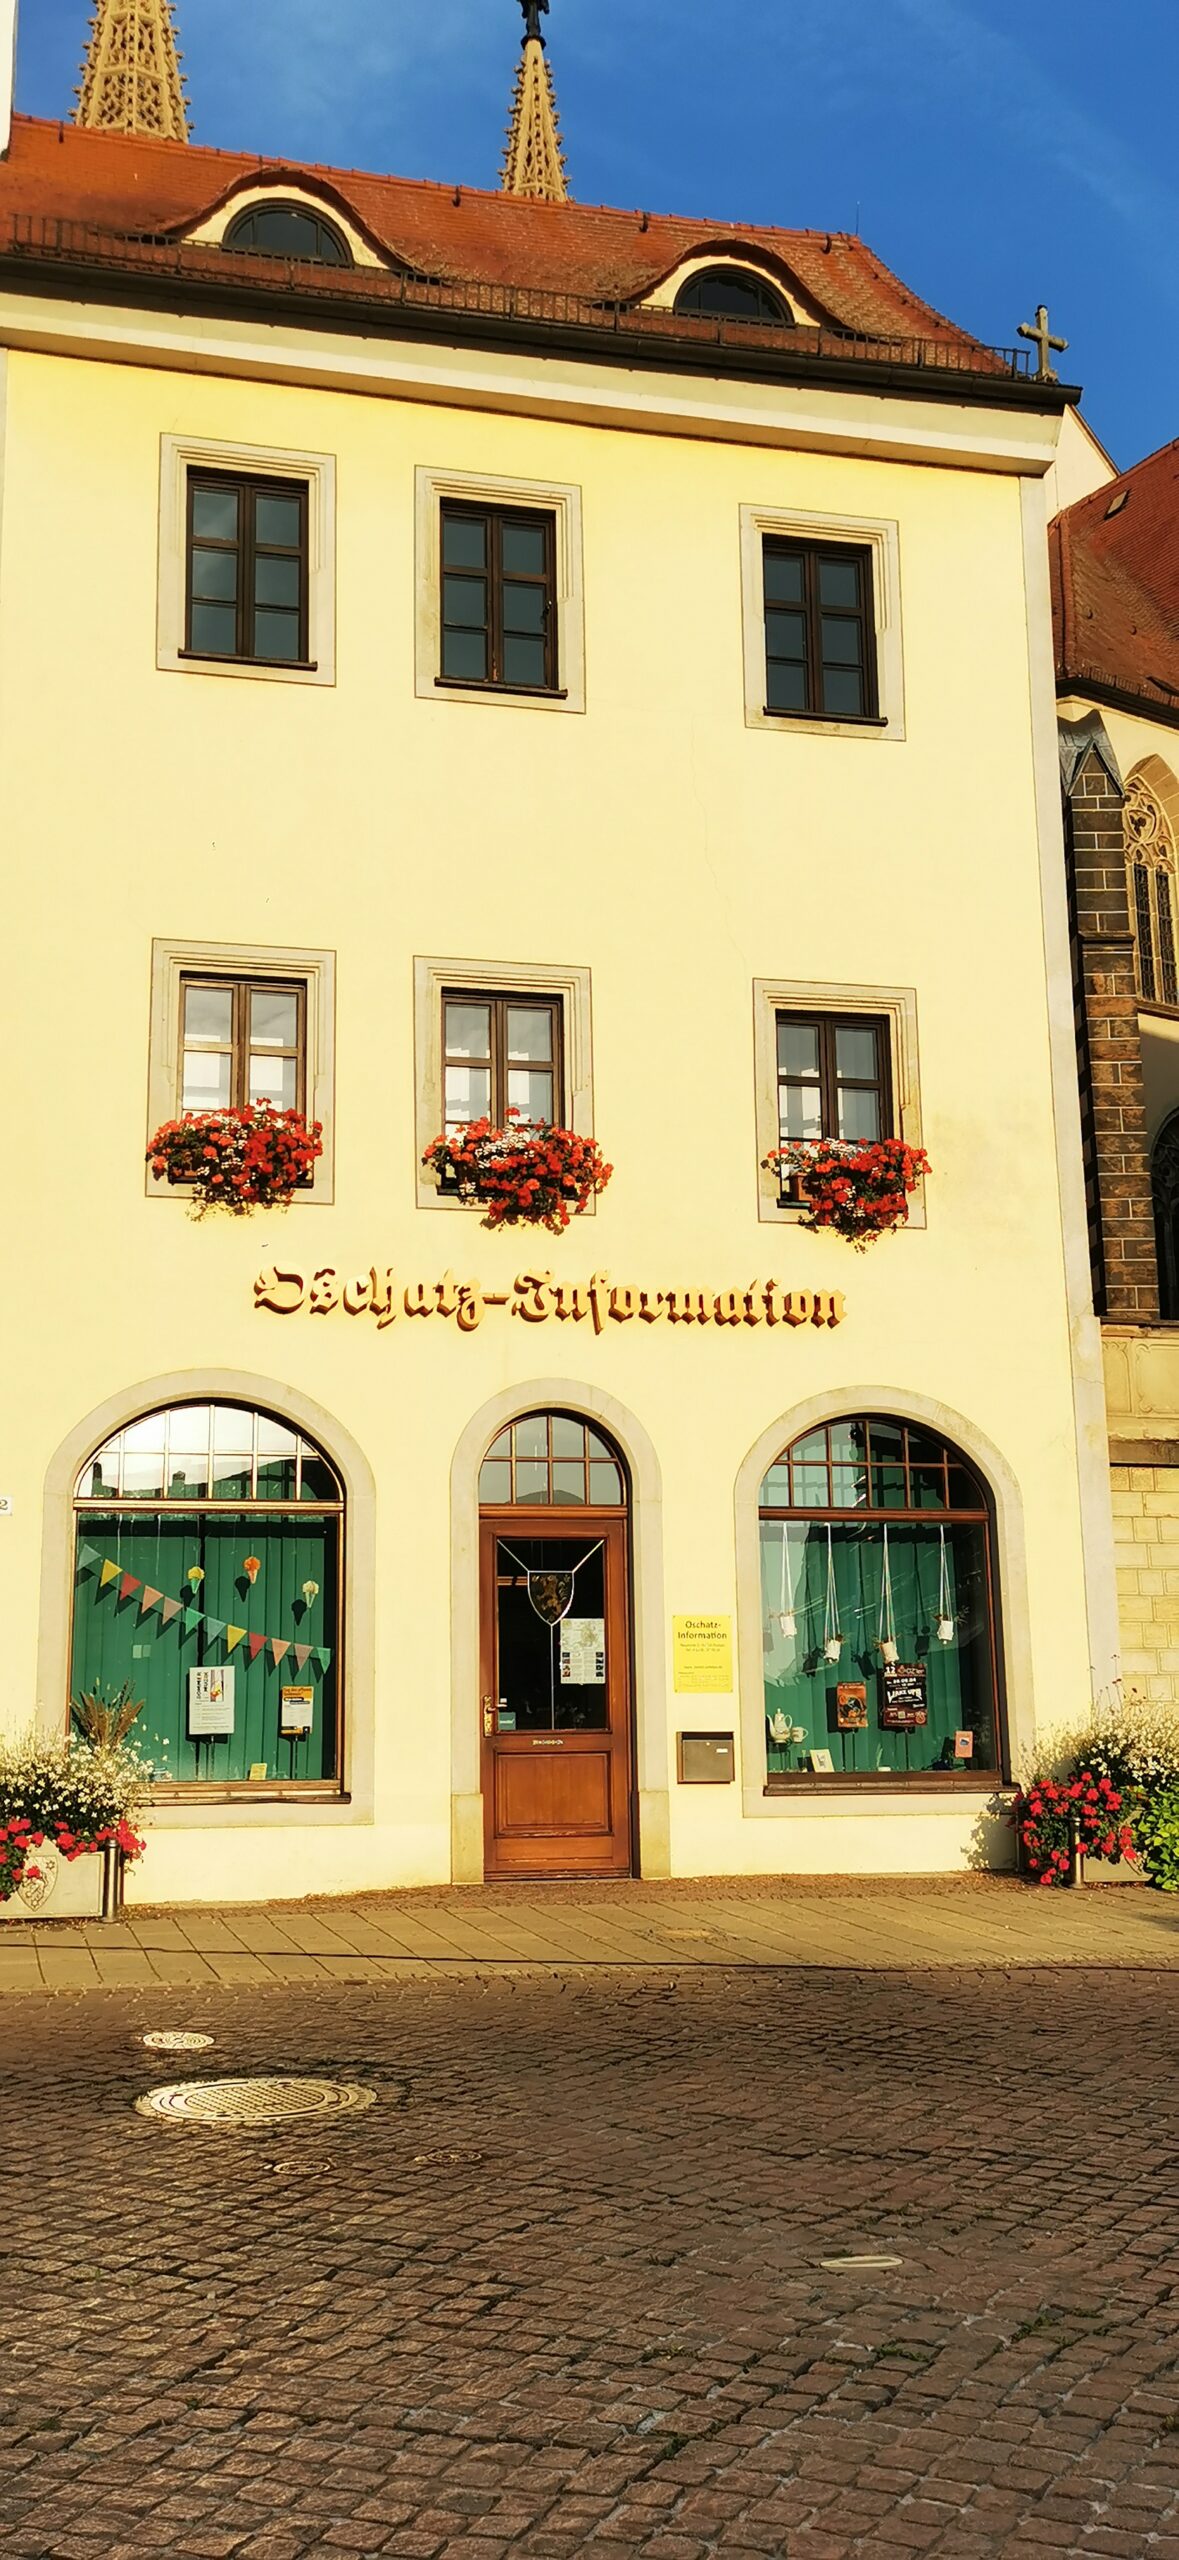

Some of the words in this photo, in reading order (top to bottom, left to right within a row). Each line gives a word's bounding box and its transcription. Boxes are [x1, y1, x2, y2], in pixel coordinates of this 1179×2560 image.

[253, 1262, 848, 1336] Oschatz-Information
[685, 1620, 721, 1629] Oschatz-
[677, 1631, 727, 1640] Information
